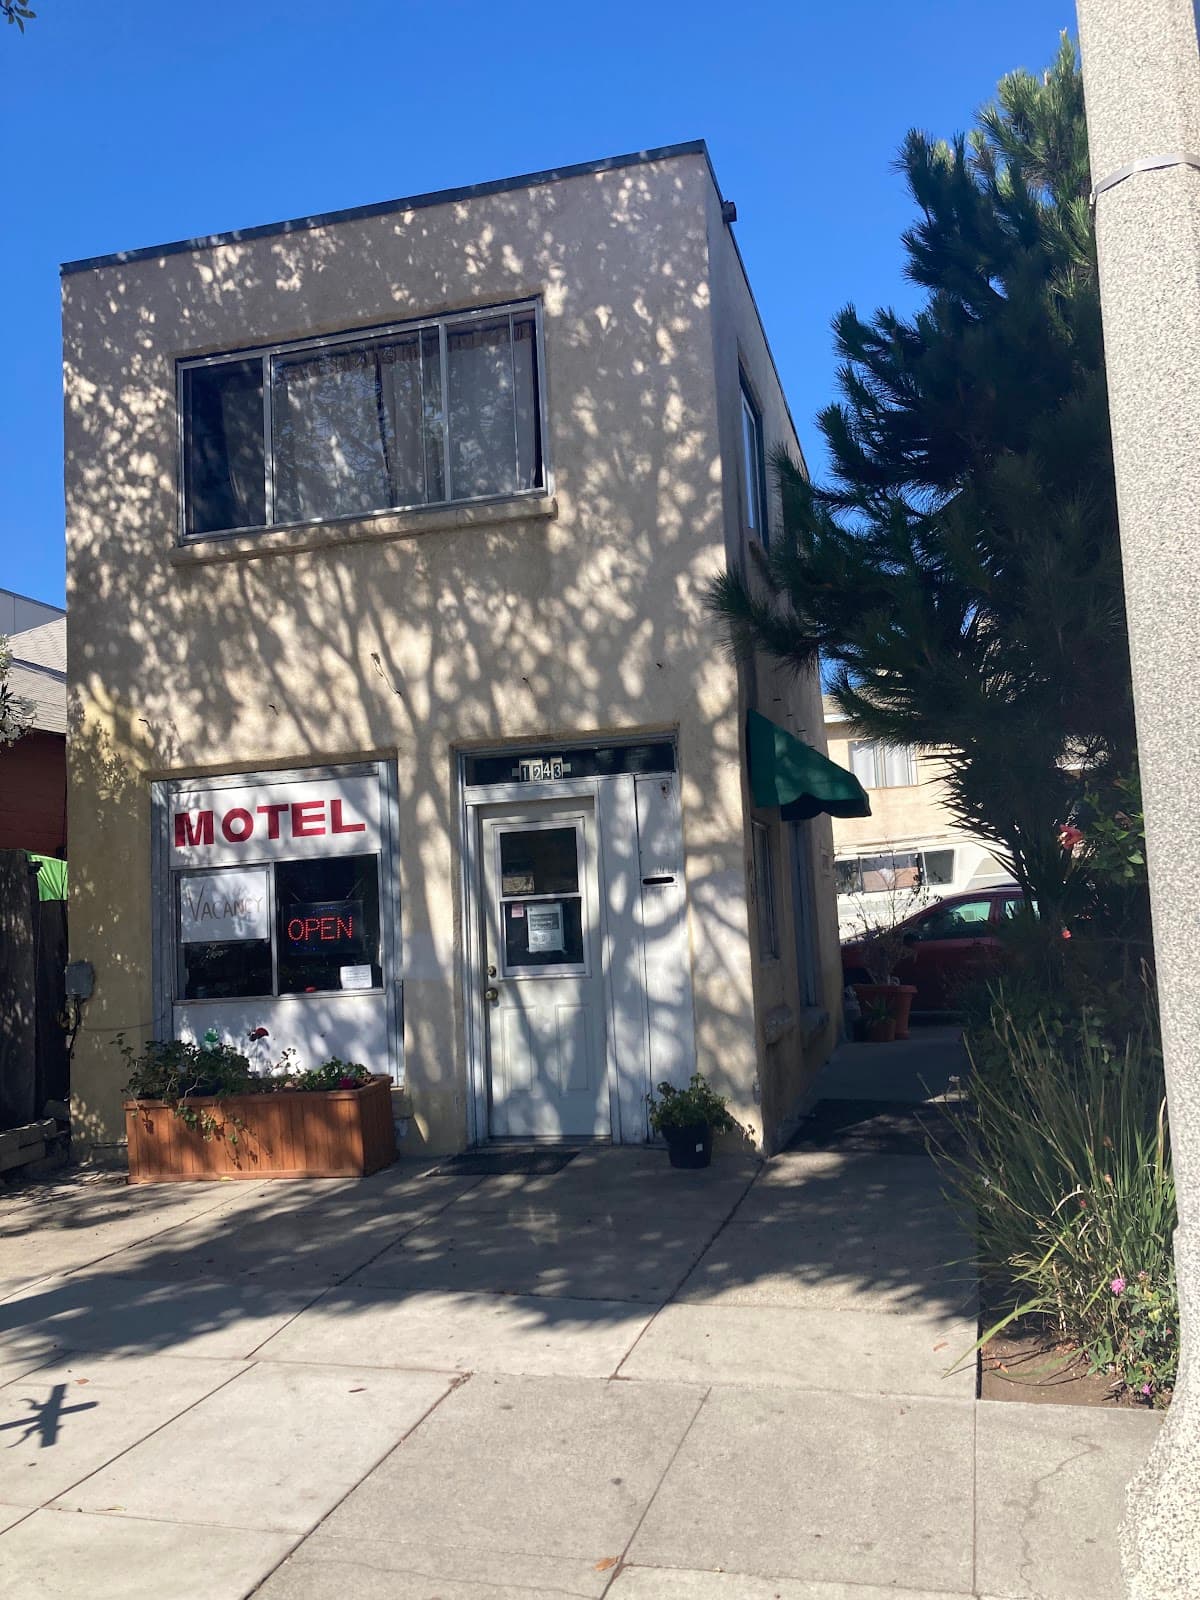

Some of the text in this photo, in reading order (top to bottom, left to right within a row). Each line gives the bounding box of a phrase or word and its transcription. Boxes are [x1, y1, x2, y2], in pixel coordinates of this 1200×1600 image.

[523, 762, 561, 780] 1243
[175, 799, 366, 848] MOTEL
[287, 916, 353, 941] OPEN
